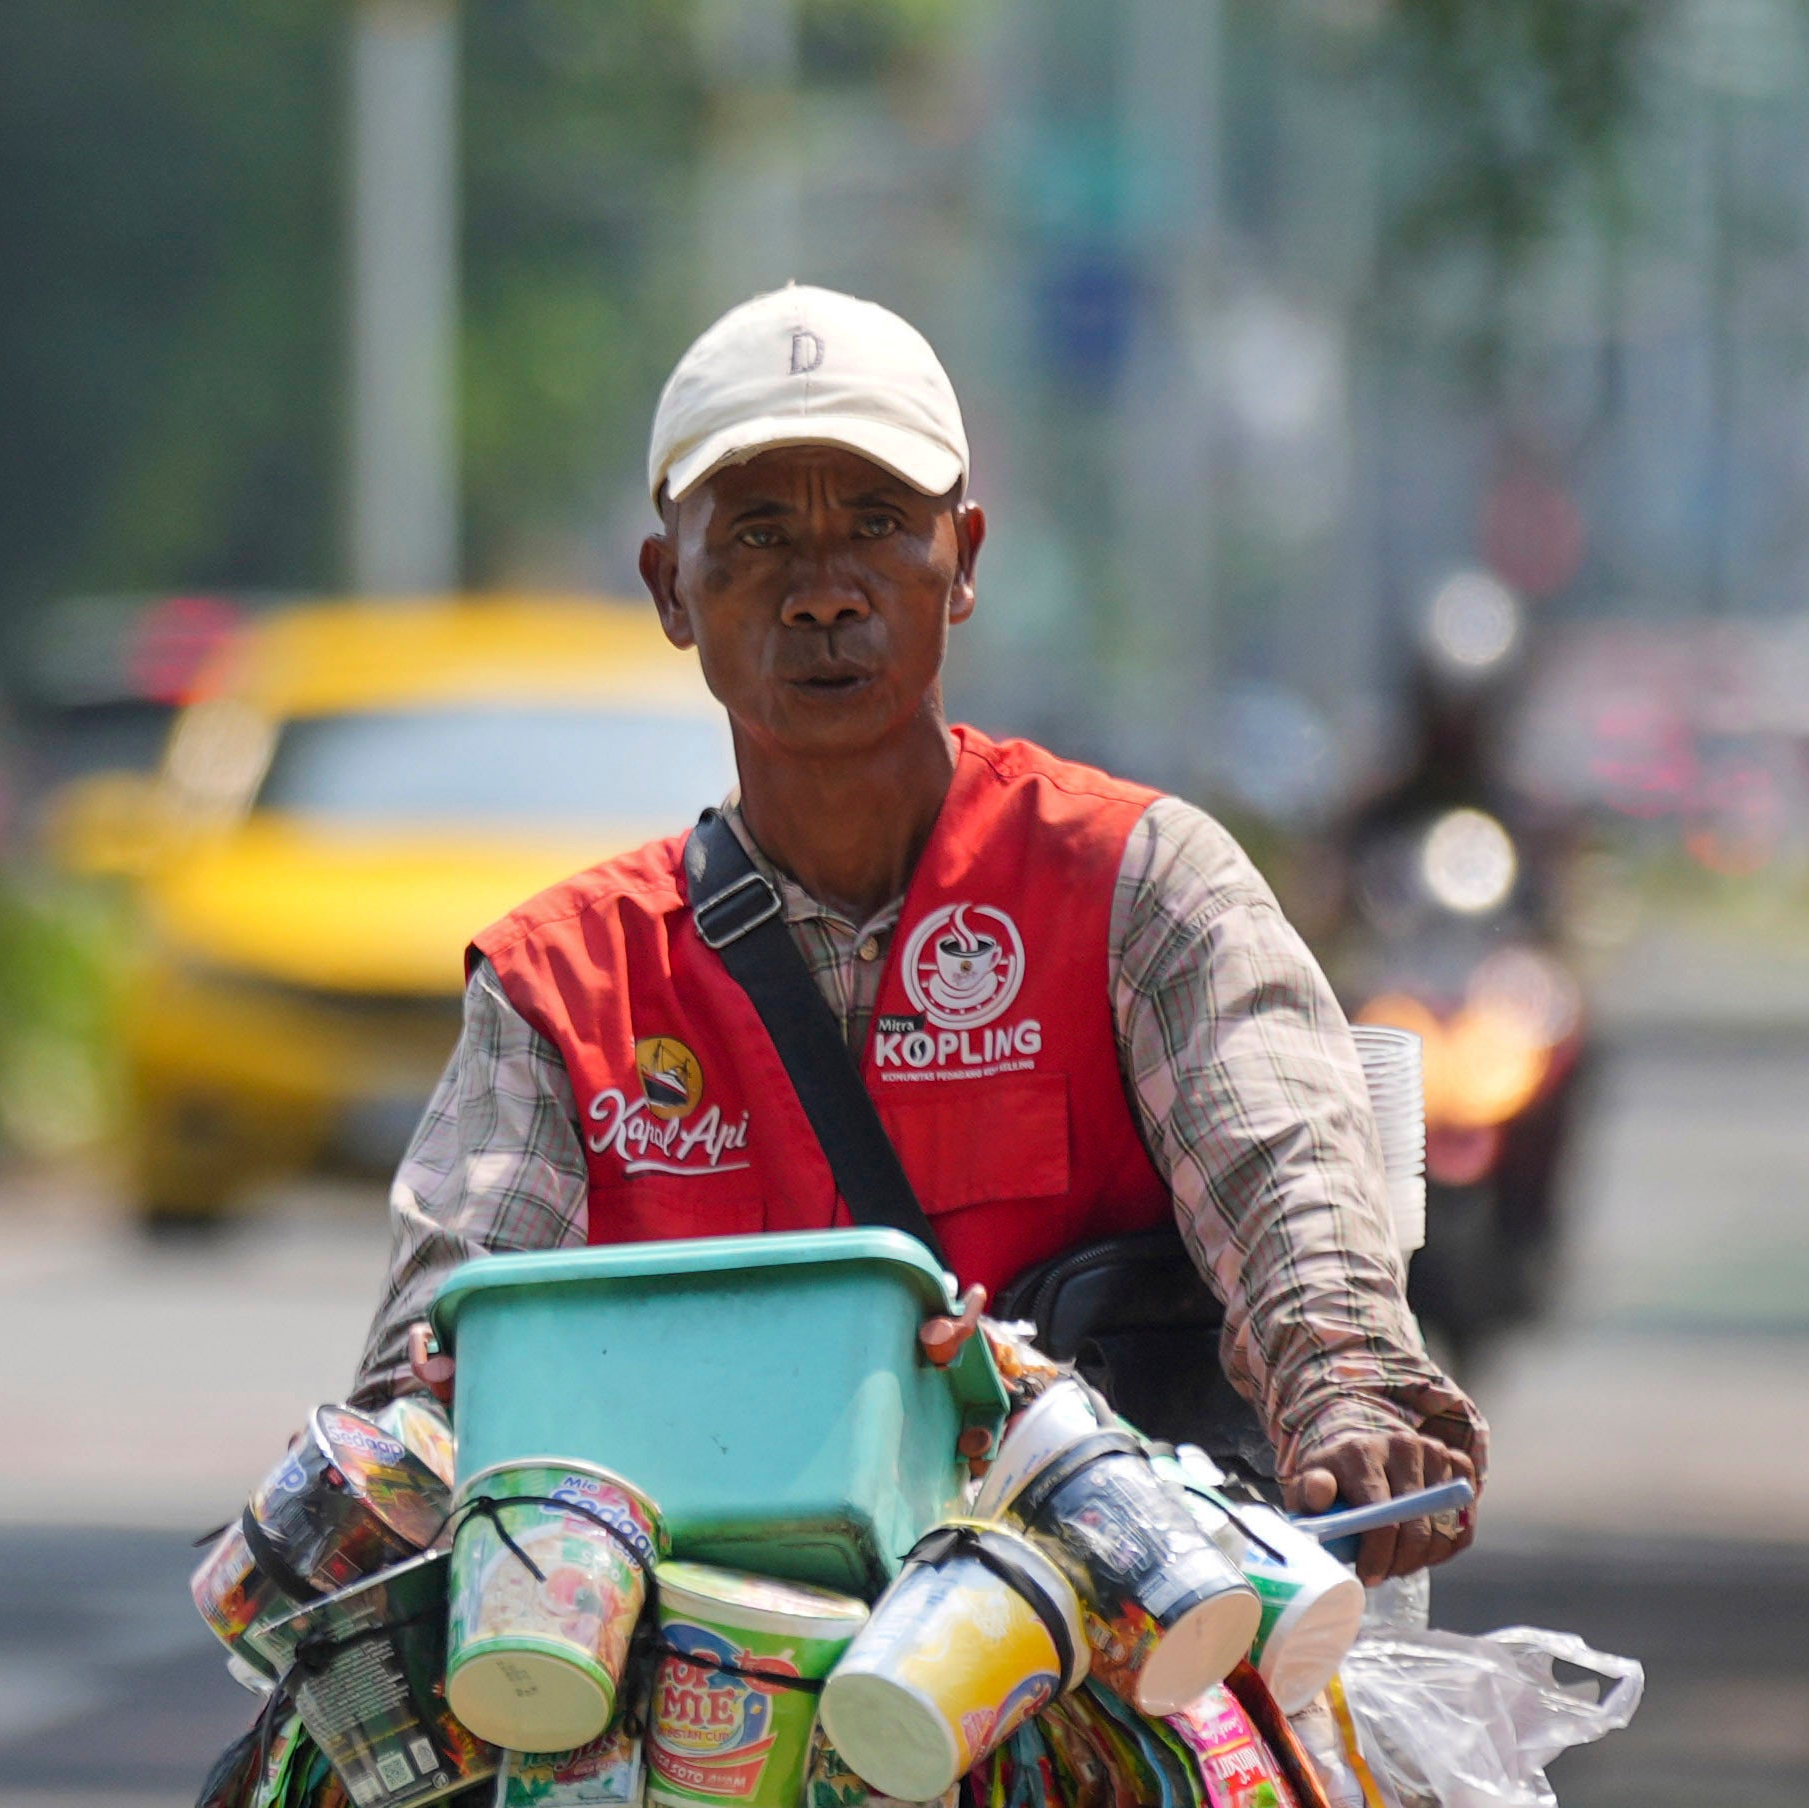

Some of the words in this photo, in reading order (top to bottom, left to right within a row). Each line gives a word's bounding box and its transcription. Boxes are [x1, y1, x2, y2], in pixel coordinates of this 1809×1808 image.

[789, 327, 826, 376] D
[875, 1019, 1042, 1068] KOPLING
[878, 1019, 916, 1033] Mitra
[589, 1087, 682, 1162] Kapal
[676, 1103, 750, 1167] Api
[562, 1475, 599, 1492] Mie
[661, 1686, 736, 1727] MIE
[671, 1763, 704, 1784] SOTO
